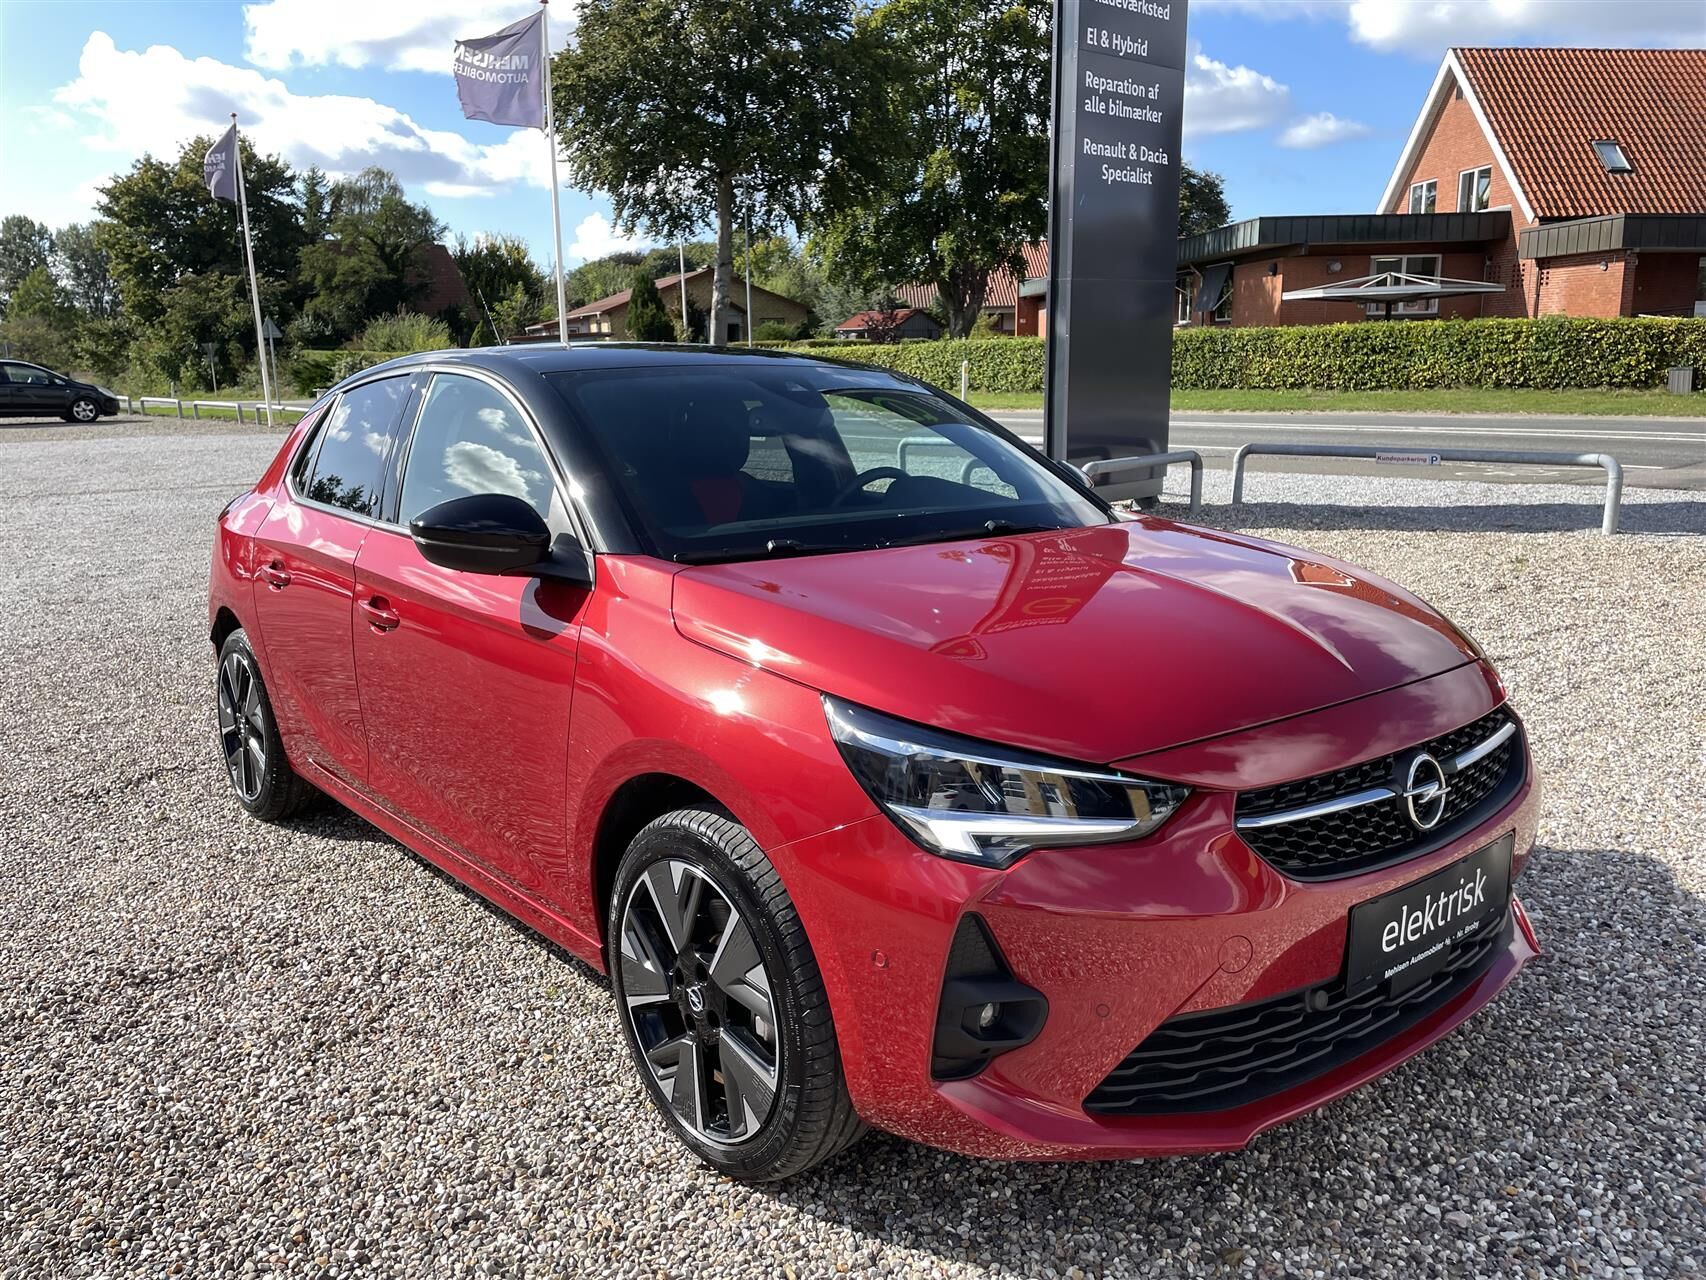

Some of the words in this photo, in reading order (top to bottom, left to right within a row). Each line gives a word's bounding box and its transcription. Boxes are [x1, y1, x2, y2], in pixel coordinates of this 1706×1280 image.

[1087, 28, 1097, 46] El
[1101, 30, 1109, 48] &
[1112, 33, 1148, 56] Hybrid
[1085, 71, 1145, 98] Reparation
[1148, 84, 1159, 100] af
[1084, 96, 1106, 114] alle
[1109, 98, 1163, 123] bilmærker
[1083, 138, 1127, 159] Renault
[1129, 143, 1137, 161] &
[1140, 146, 1168, 165] Dacia
[1102, 165, 1153, 185] Specialist
[1377, 455, 1427, 463] Kundeparkering
[1381, 868, 1487, 952] elektrisk
